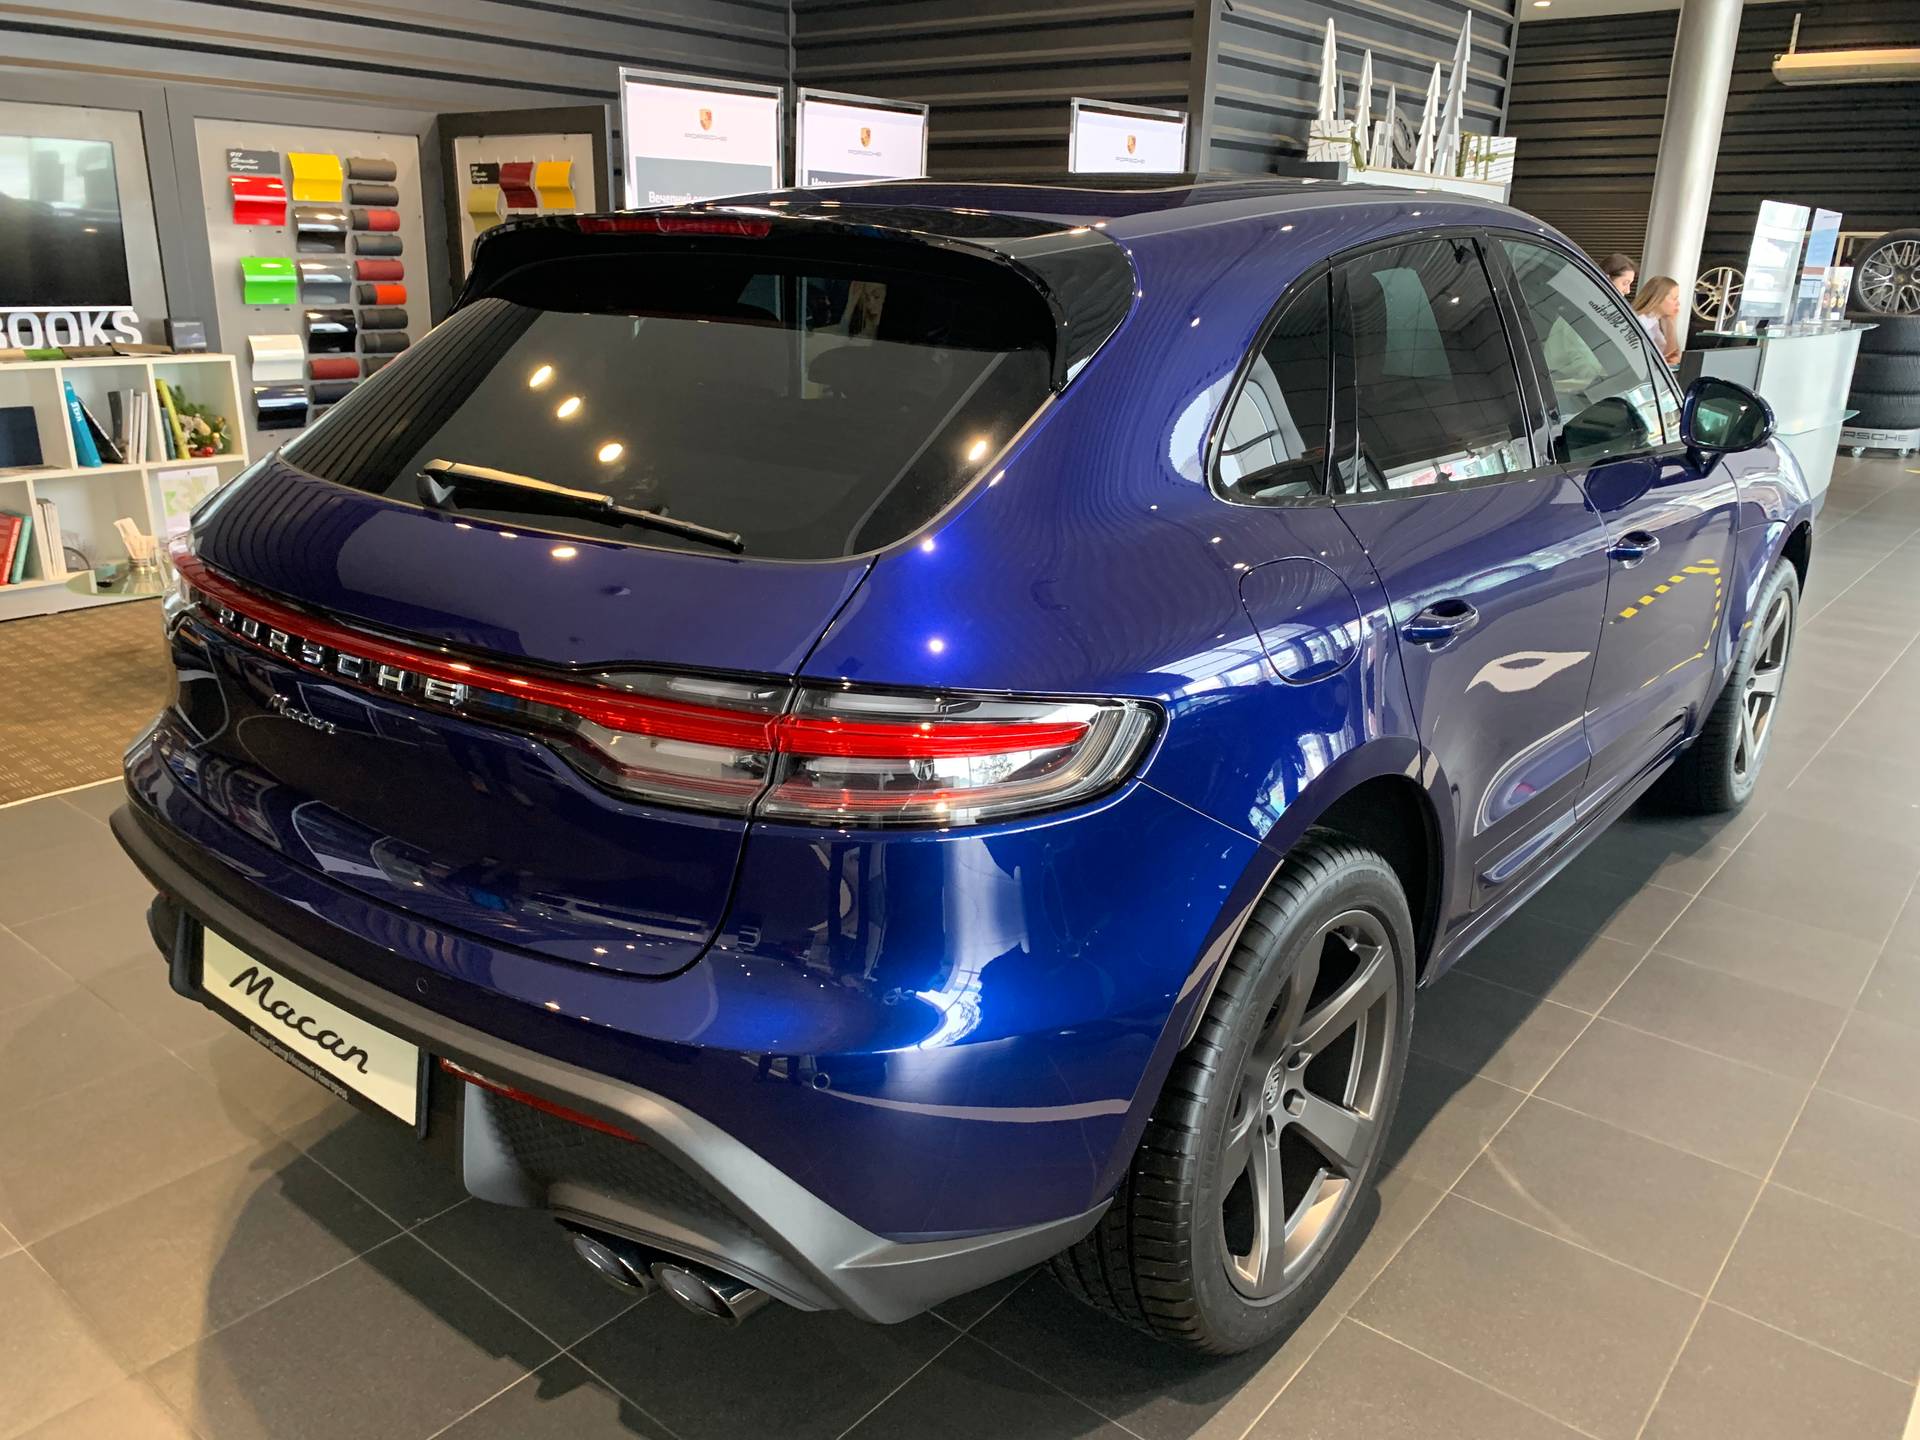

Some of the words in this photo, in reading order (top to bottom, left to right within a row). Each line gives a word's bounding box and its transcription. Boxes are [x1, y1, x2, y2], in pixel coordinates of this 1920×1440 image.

[0, 311, 143, 349] OOKS
[1841, 430, 1909, 442] RSCHE
[219, 606, 464, 706] PORSCHE
[268, 693, 337, 735] Macan
[229, 966, 368, 1074] Macan
